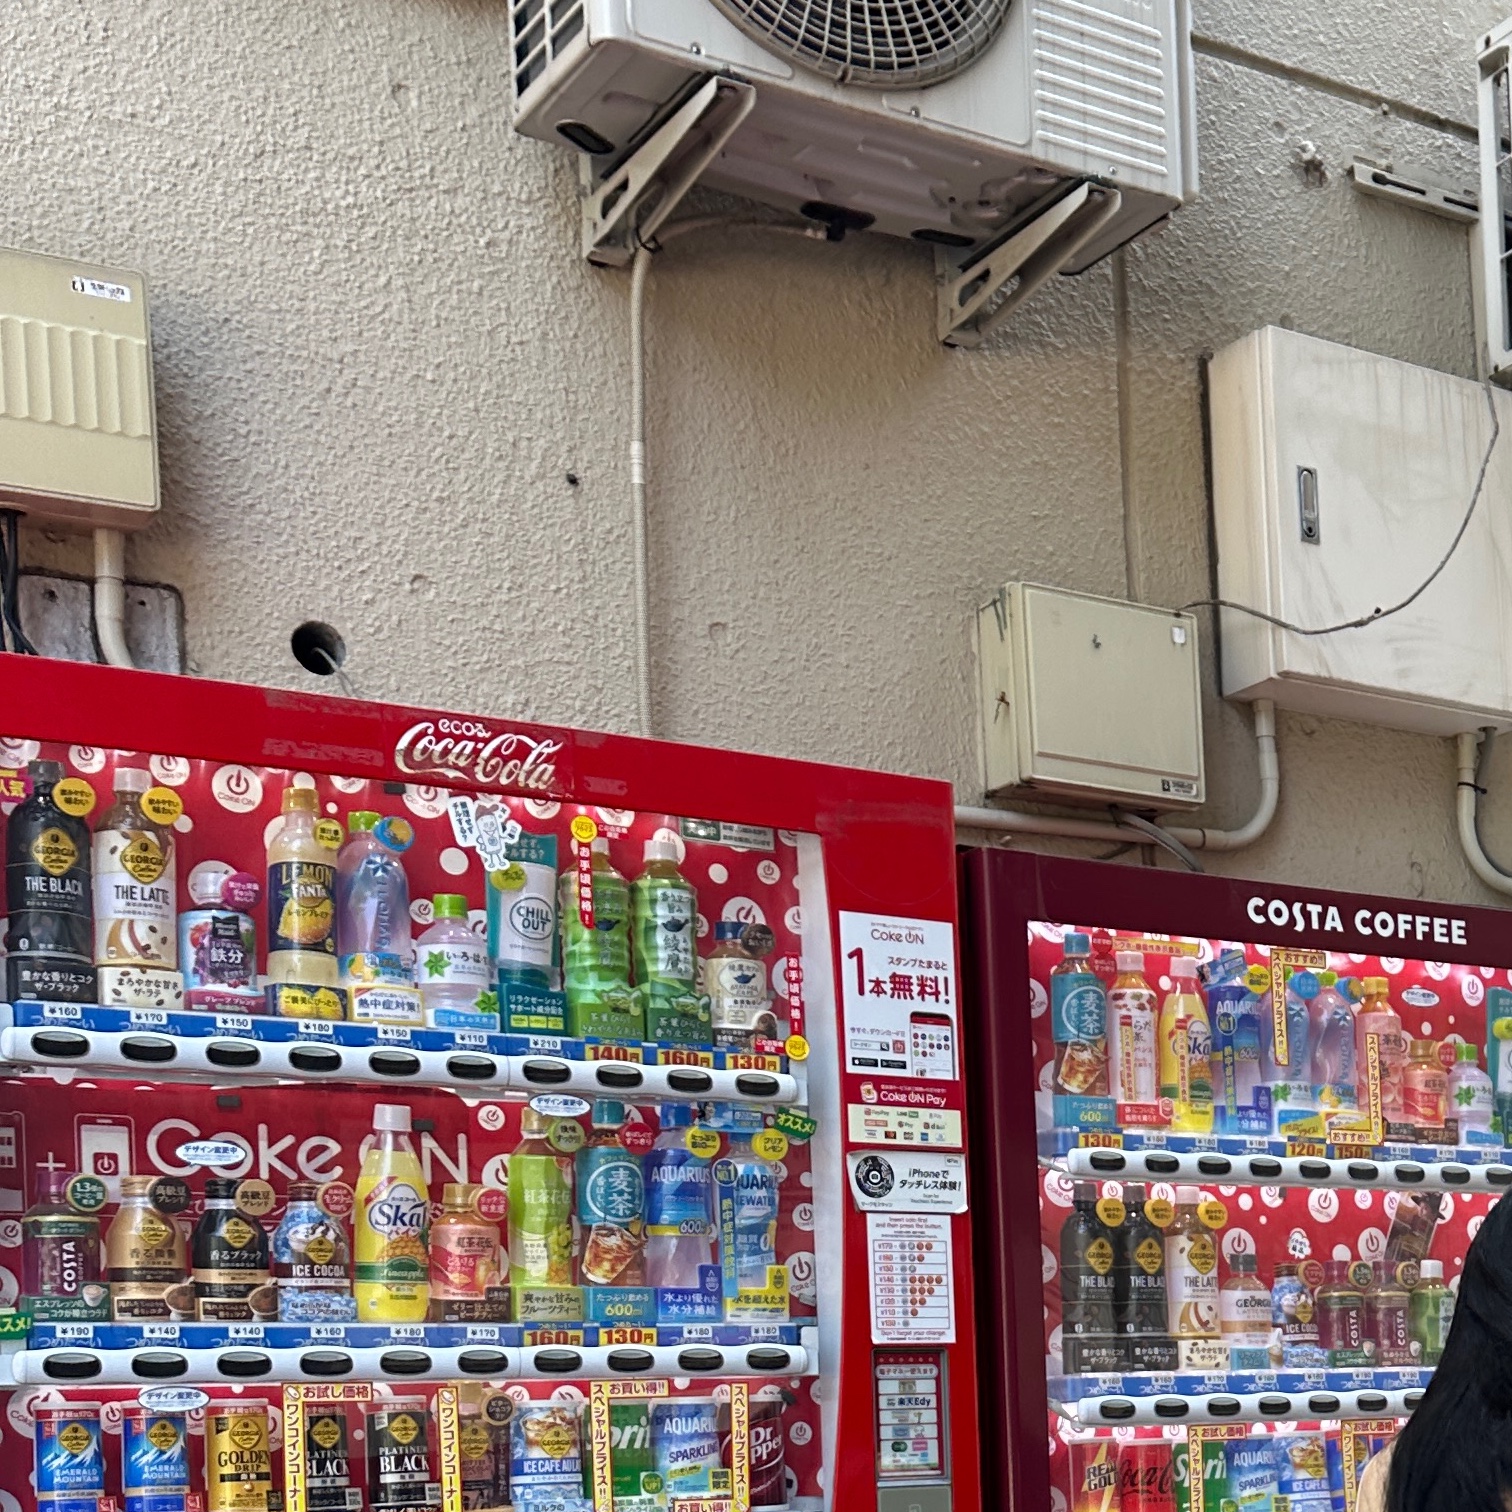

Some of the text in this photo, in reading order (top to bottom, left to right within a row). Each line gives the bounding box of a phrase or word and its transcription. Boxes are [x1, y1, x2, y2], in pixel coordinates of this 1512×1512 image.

[394, 720, 564, 793] Coca-Cola
[281, 863, 334, 886] LEMON
[25, 876, 48, 892] THE
[114, 885, 138, 901] THE
[516, 904, 551, 922] CHILL
[1247, 896, 1468, 946] COSTA COFFEE
[522, 916, 548, 931] OUT
[210, 947, 243, 964] 鉄分
[887, 956, 949, 970] スタンプたまると
[48, 1006, 78, 1017] ¥160
[134, 1012, 163, 1023] ¥170
[1081, 993, 1100, 1033] 麦茶
[589, 1046, 641, 1063] 140円
[660, 1051, 711, 1067] 160円
[728, 1054, 778, 1071] 130円
[879, 1090, 908, 1103] Coke
[926, 1093, 947, 1108] Pay
[145, 1117, 344, 1180] Coke
[608, 1167, 633, 1216] 麦茶
[62, 1241, 77, 1293] COSTA
[292, 1264, 345, 1278] ICE COCOA
[603, 1328, 654, 1346] 130円
[1350, 1309, 1359, 1347] COSTA
[1396, 1309, 1407, 1347] COSTA
[529, 1330, 581, 1346] 160円
[302, 1385, 369, 1400] お試し価格
[750, 1426, 772, 1445] Dr
[286, 1403, 302, 1512] ワンコインコーナー
[442, 1405, 456, 1512] ワンコインコーナー
